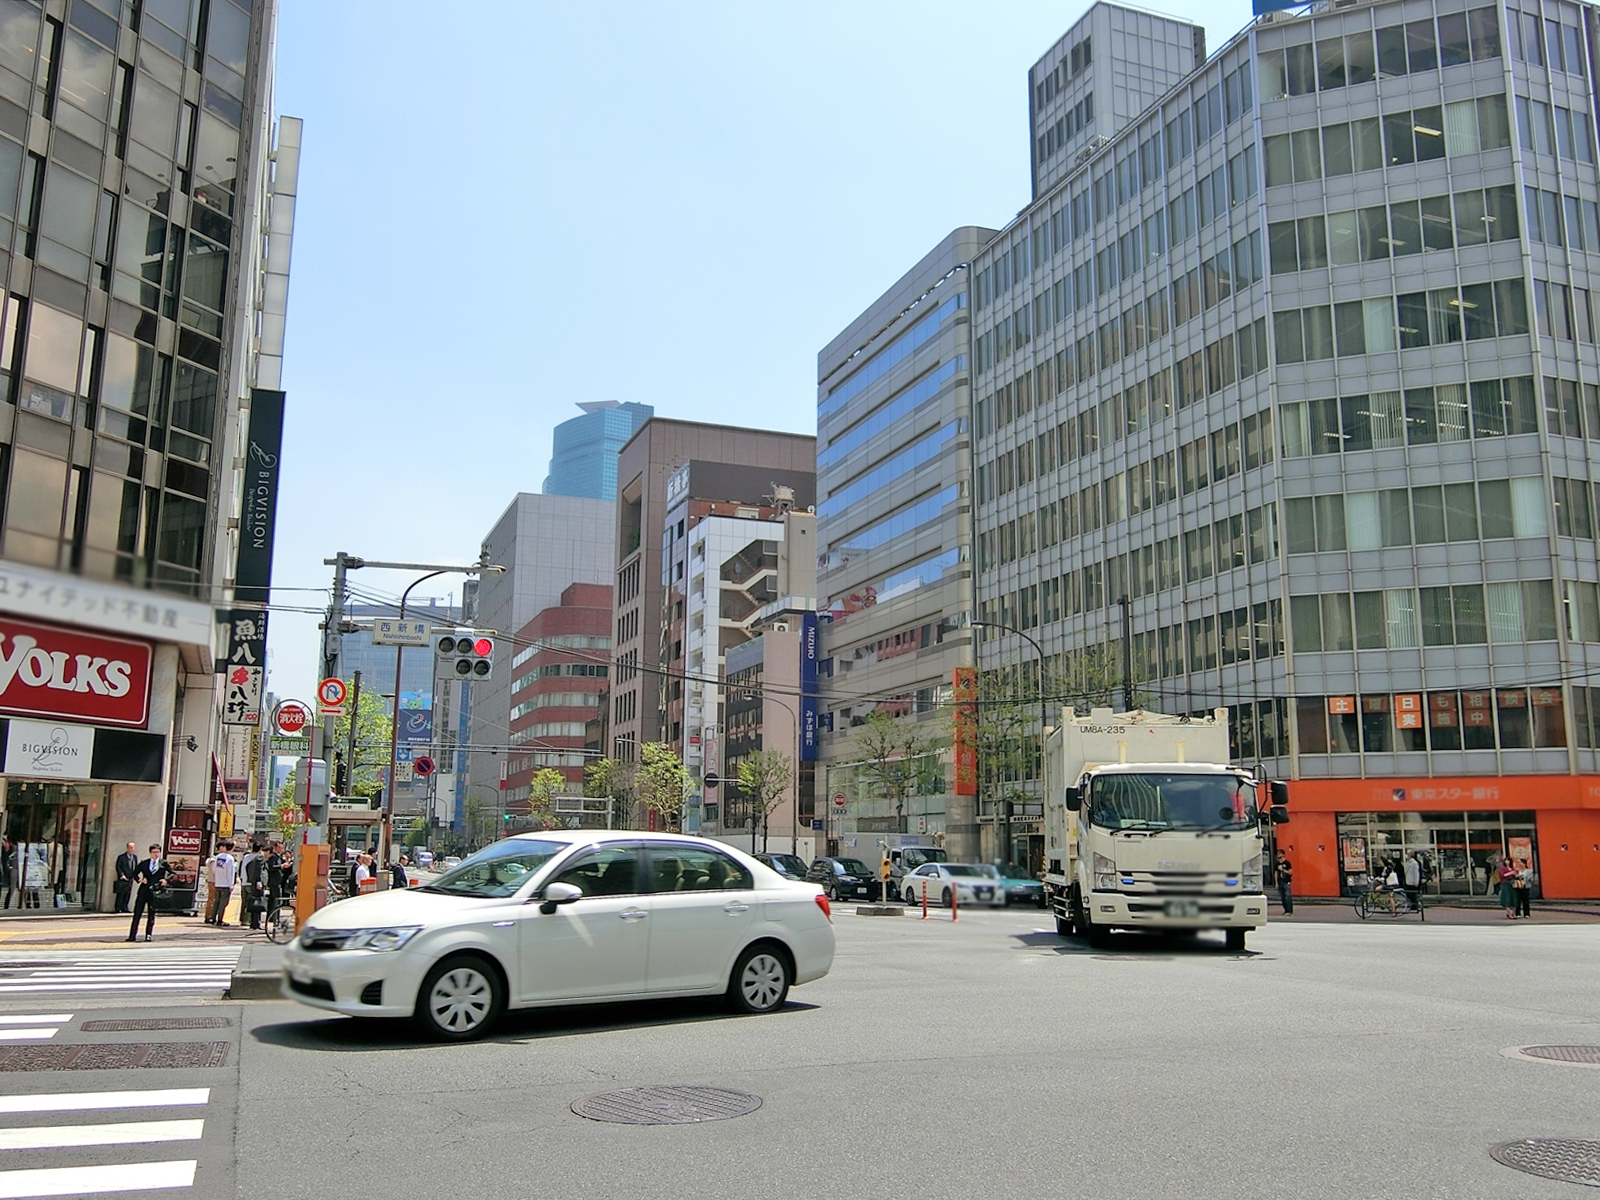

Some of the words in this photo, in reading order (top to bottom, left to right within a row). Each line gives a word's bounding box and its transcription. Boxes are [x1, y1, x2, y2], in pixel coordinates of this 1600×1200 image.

[252, 471, 270, 548] BIGVISION
[381, 622, 425, 634] 西新橋
[231, 619, 257, 664] 魚八
[807, 626, 816, 659] MIZUHO
[0, 632, 131, 697] VOLKS
[1336, 690, 1553, 712] 土曜日も相談会
[280, 712, 304, 724] 消火栓
[1403, 712, 1485, 726] 実施中
[1080, 726, 1126, 734] UM8A-235
[22, 743, 78, 756] BIGVISION
[1410, 788, 1499, 800] 東京スター銀行
[171, 836, 200, 846] VOLKS
